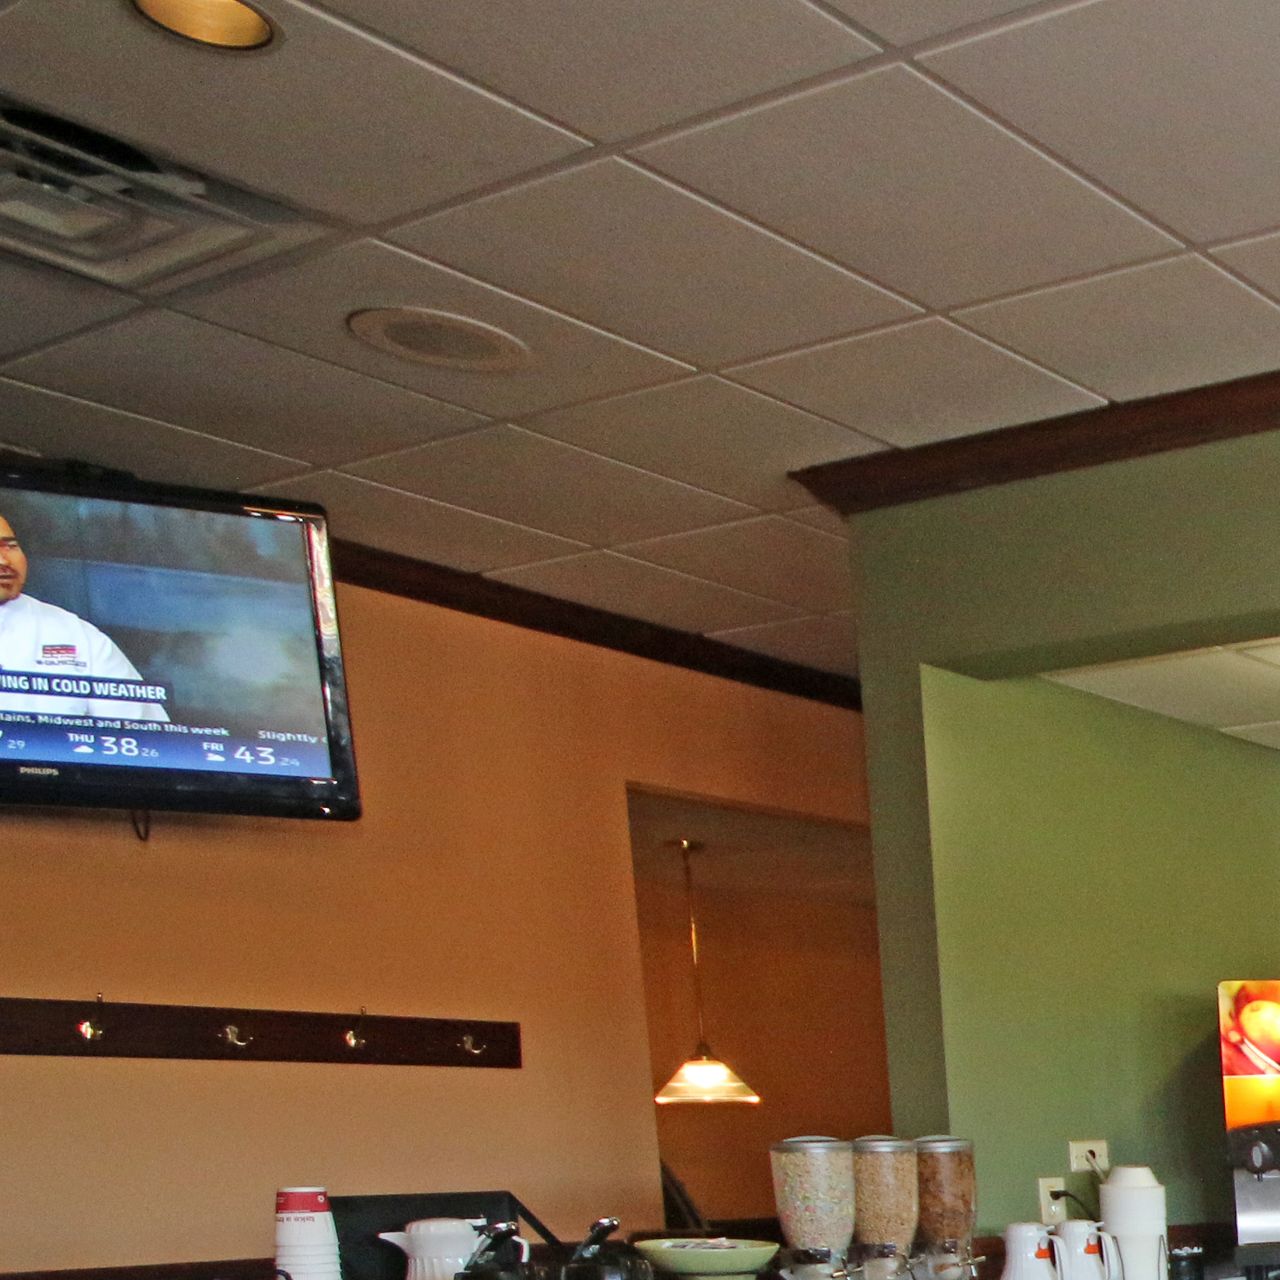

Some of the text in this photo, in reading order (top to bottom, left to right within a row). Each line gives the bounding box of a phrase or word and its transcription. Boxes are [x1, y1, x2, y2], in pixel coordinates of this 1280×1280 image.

[0, 675, 167, 700] ING IN COLD WEATHER
[0, 713, 230, 737] lains, Midwest and South this week
[66, 732, 95, 743] THU
[257, 729, 318, 744] Slightly
[7, 739, 26, 750] 29
[100, 735, 139, 757] 38
[202, 741, 225, 752] FRI
[141, 747, 160, 758] 26
[233, 745, 276, 765] 43
[19, 766, 59, 776] PHILIPS
